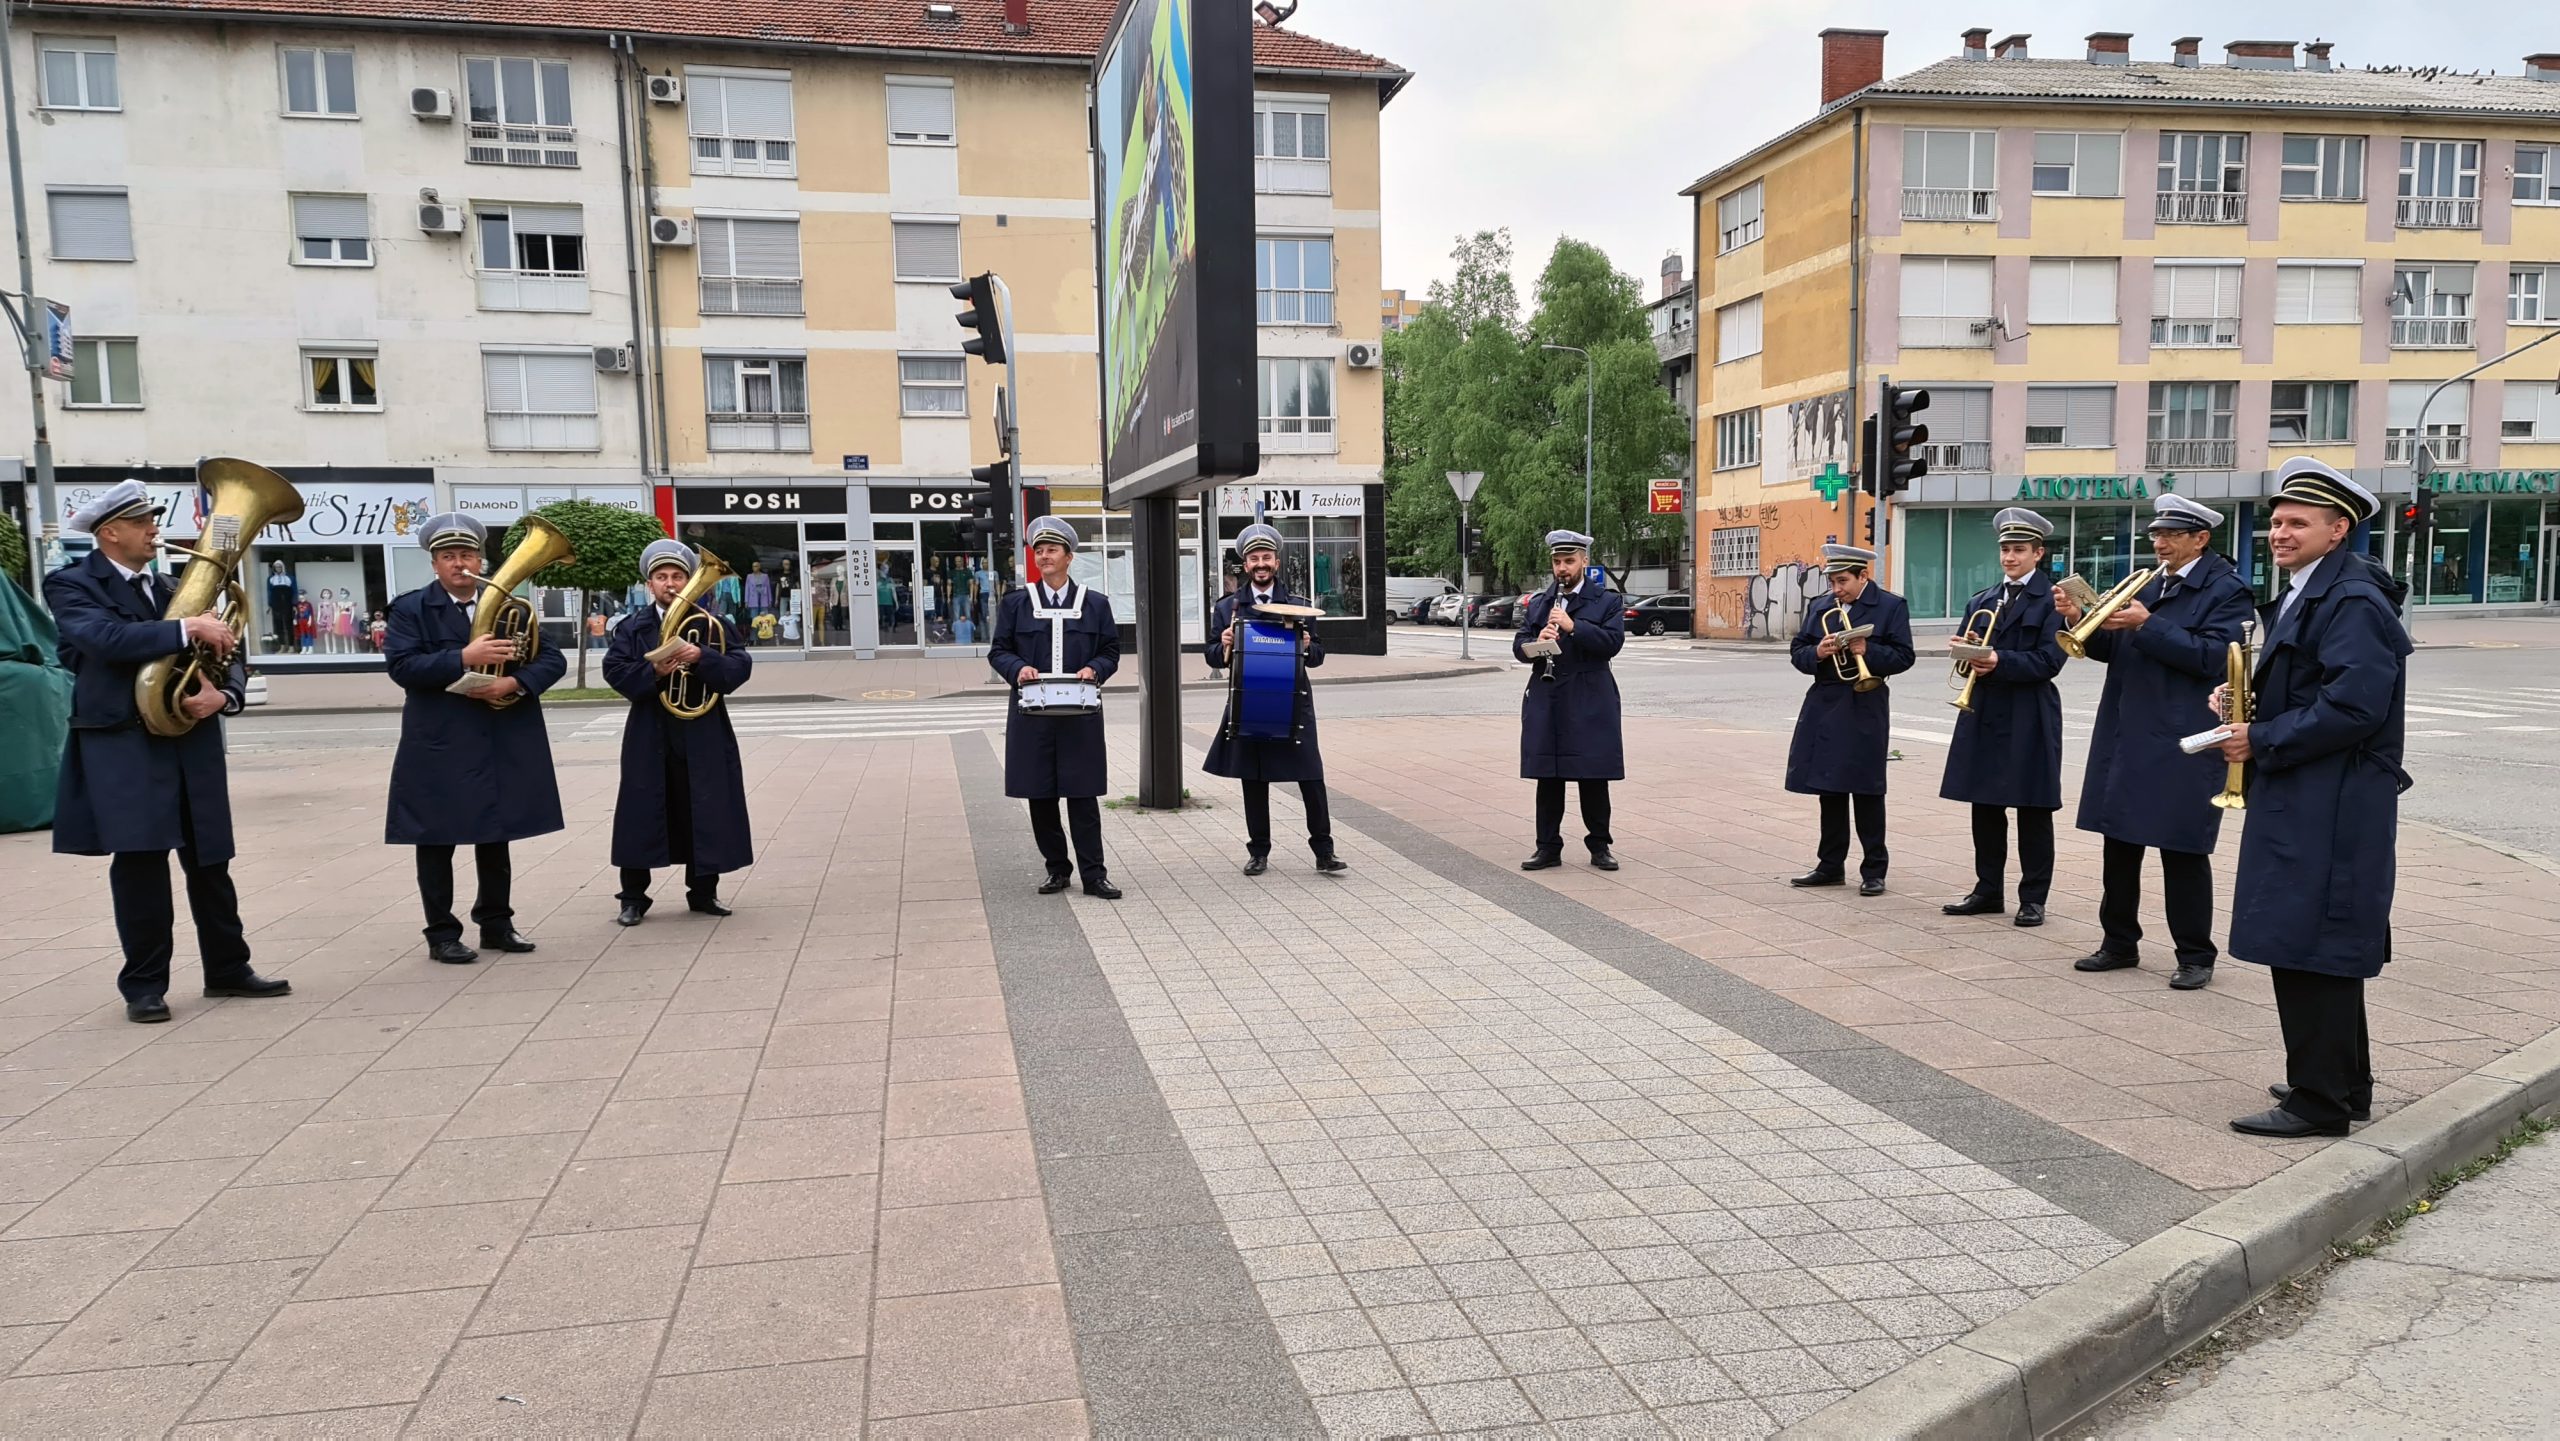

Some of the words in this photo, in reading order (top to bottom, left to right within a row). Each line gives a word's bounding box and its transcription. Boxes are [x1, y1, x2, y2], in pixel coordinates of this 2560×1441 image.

[2014, 476, 2149, 500] АПОТЕКА
[459, 501, 518, 510] DIAMOND
[725, 493, 800, 509] POSH
[1264, 490, 1302, 511] EM
[1311, 493, 1361, 507] Fashion
[309, 494, 393, 537] Stil
[852, 550, 860, 587] MODNI
[1590, 568, 1600, 581] P
